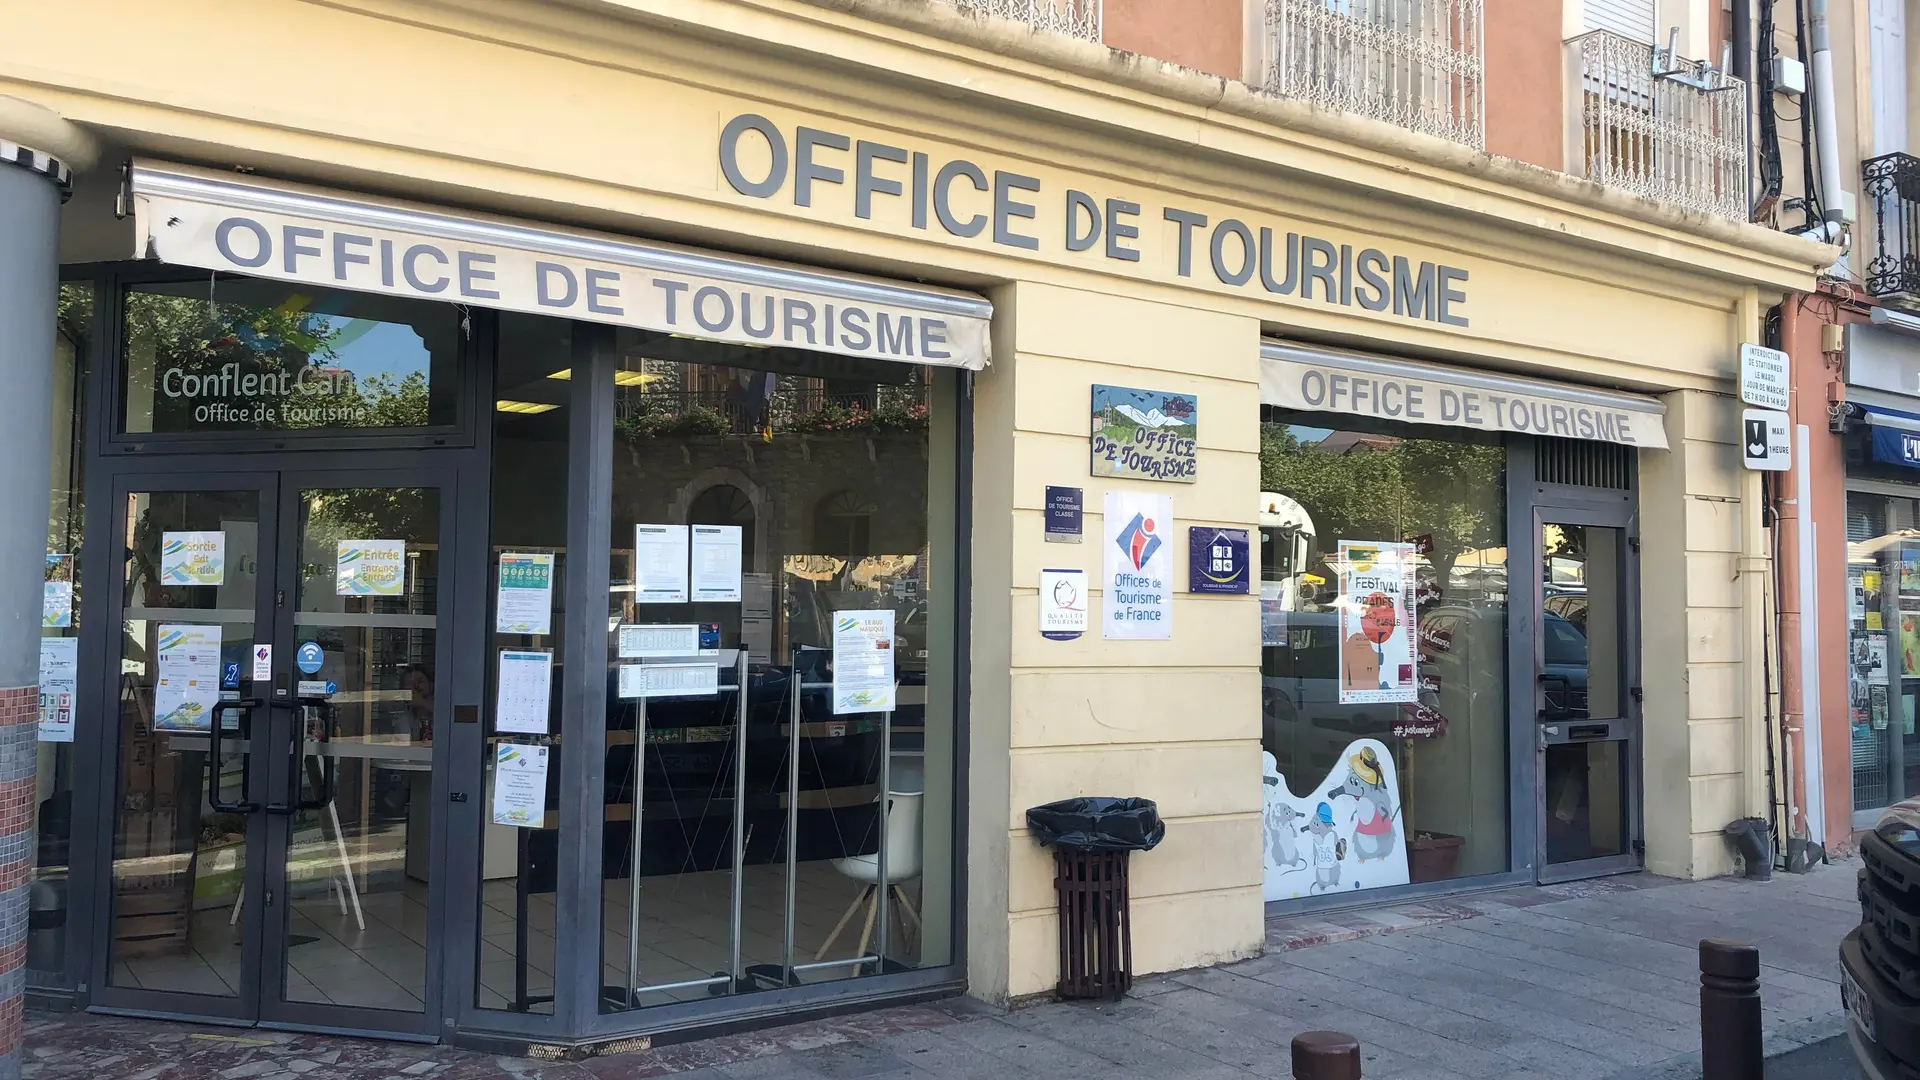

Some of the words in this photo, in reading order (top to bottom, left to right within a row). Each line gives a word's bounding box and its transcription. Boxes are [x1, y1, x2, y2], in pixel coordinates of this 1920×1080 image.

[719, 113, 1041, 251] OFFICE
[1066, 190, 1140, 262] DE
[1163, 206, 1469, 328] TOURISME
[215, 217, 500, 300] OFFICE
[535, 261, 624, 316] DE
[652, 278, 951, 358] TOURISME
[1749, 347, 1781, 361] INTERDICTION
[1756, 360, 1783, 373] STATIONNER
[163, 362, 291, 398] Conflent
[195, 402, 249, 423] Office
[254, 402, 276, 422] de
[281, 403, 367, 423] Tourisme
[1301, 370, 1425, 418] OFFICE
[1440, 389, 1483, 424] DE
[1489, 396, 1636, 443] TOURISME
[1772, 427, 1785, 435] MAXI
[1135, 427, 1196, 457] OFFICE
[1094, 436, 1117, 460] DE
[1121, 445, 1197, 479] TOURISME
[186, 540, 217, 552] Sortie
[363, 548, 400, 561] Entrée
[360, 563, 400, 574] Entrance
[362, 572, 397, 582] Entrada
[1114, 573, 1150, 588] Offices
[1152, 578, 1162, 588] de
[1355, 576, 1400, 593] FESTIVAL
[1114, 589, 1162, 605] Tourisme
[1114, 609, 1124, 620] de
[1126, 606, 1162, 621] France
